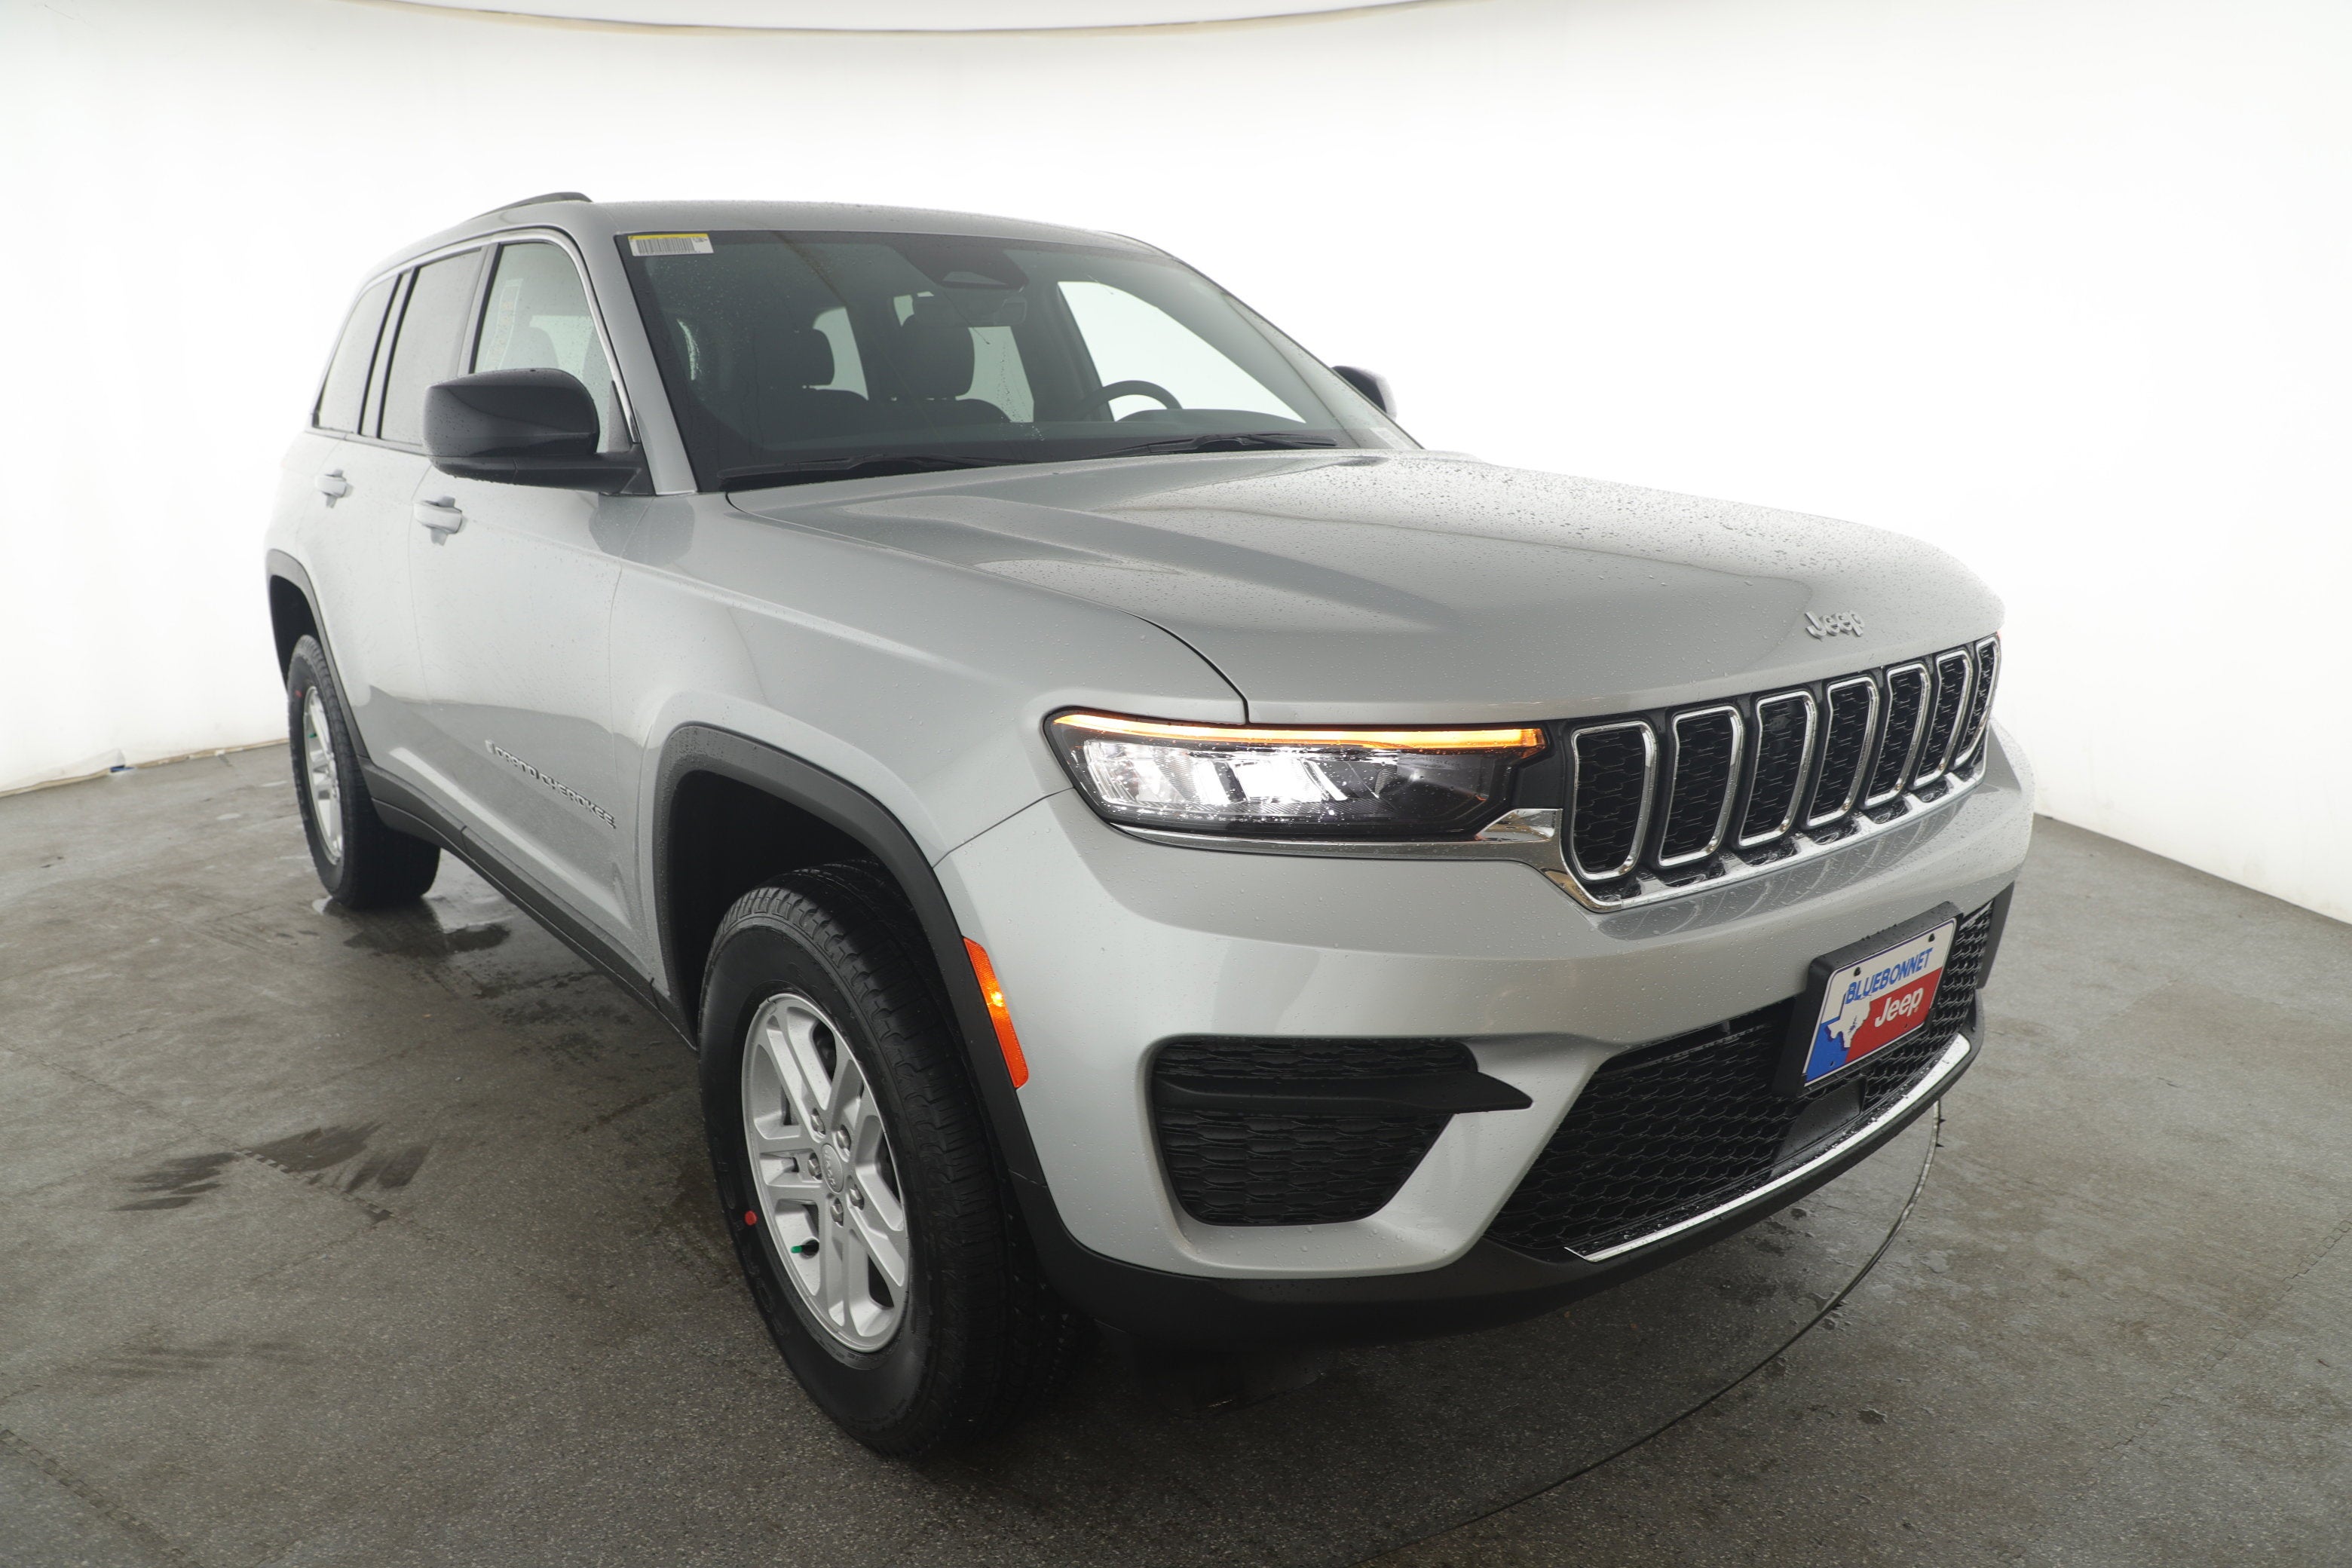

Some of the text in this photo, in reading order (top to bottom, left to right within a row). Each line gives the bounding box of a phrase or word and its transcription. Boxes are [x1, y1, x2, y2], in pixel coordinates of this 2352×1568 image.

[1805, 610, 1865, 639] Jeep
[540, 773, 617, 829] CHEROKEE
[1844, 947, 1934, 1005] BLUEBONNET
[1874, 987, 1923, 1027] Jeep
